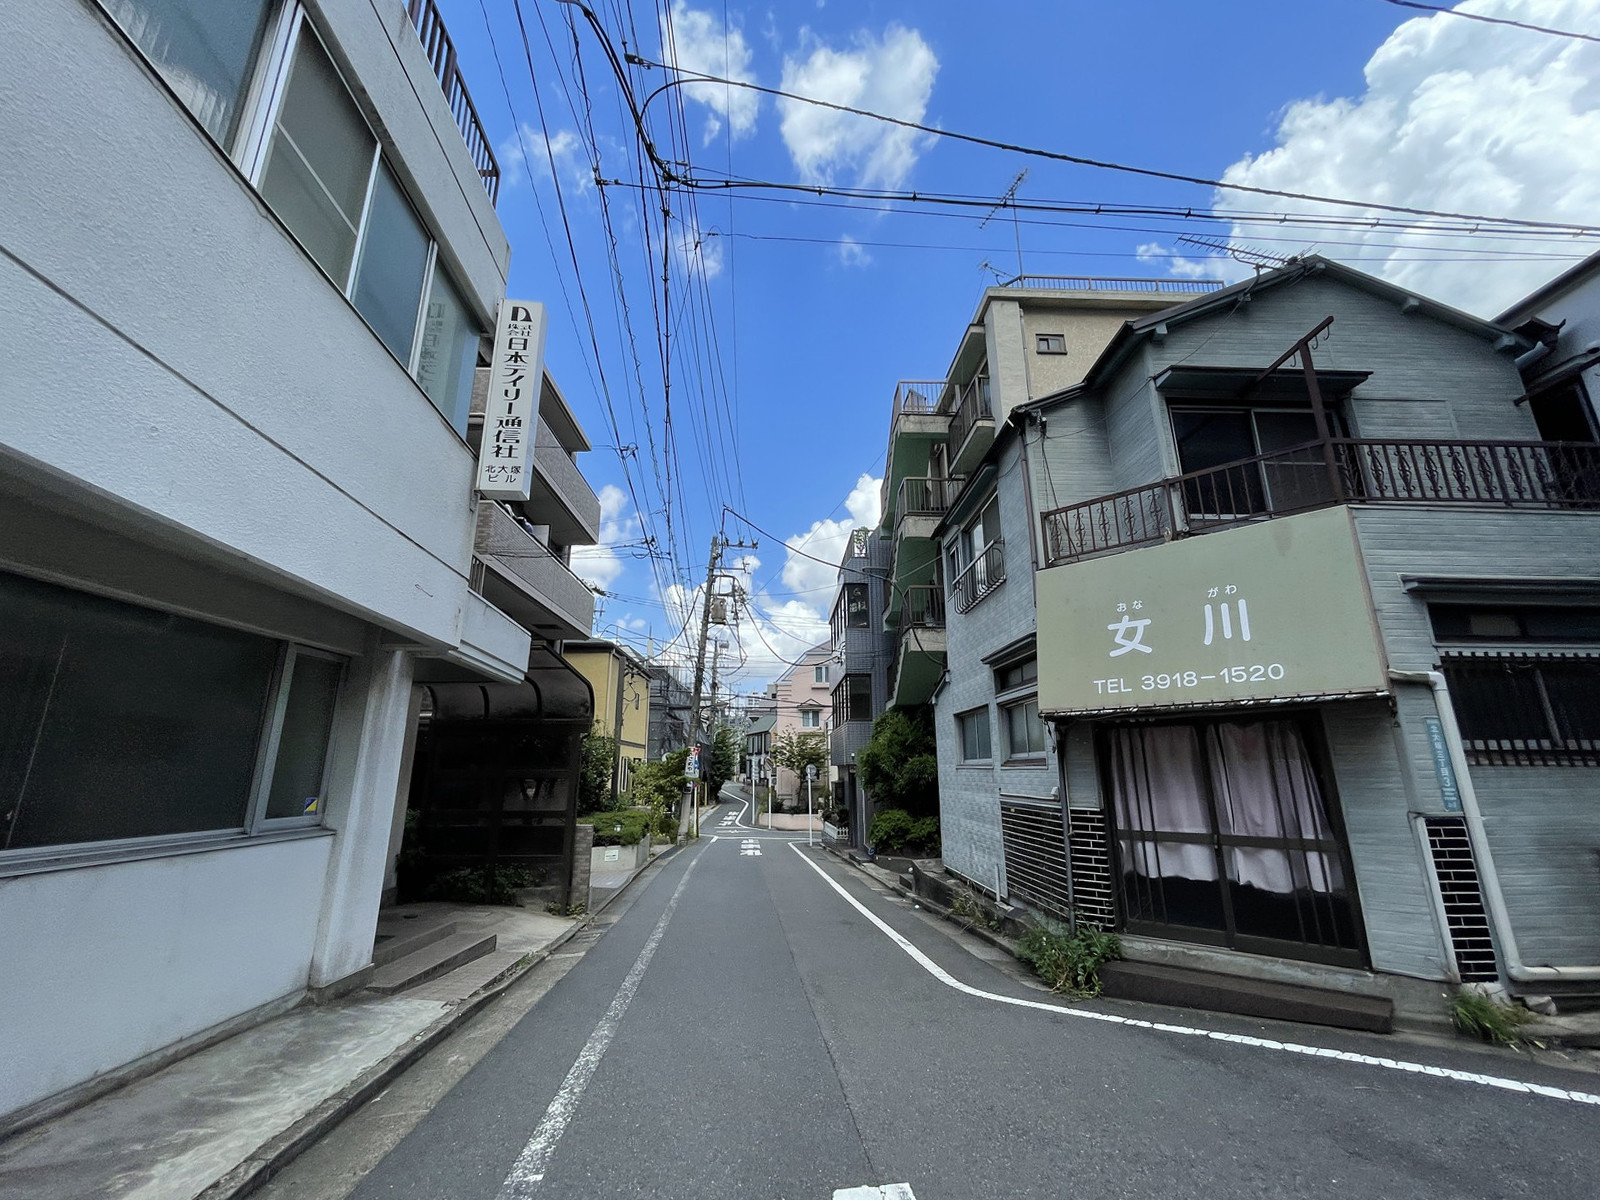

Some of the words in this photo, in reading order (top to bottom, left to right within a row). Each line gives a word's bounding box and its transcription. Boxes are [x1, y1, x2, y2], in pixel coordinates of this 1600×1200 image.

[485, 465, 521, 474] 北大塚
[488, 474, 517, 483] ビル
[1116, 600, 1143, 612] おな
[1207, 584, 1237, 598] がわ
[1093, 678, 1132, 694] TEL
[1141, 664, 1285, 690] 3918-1520
